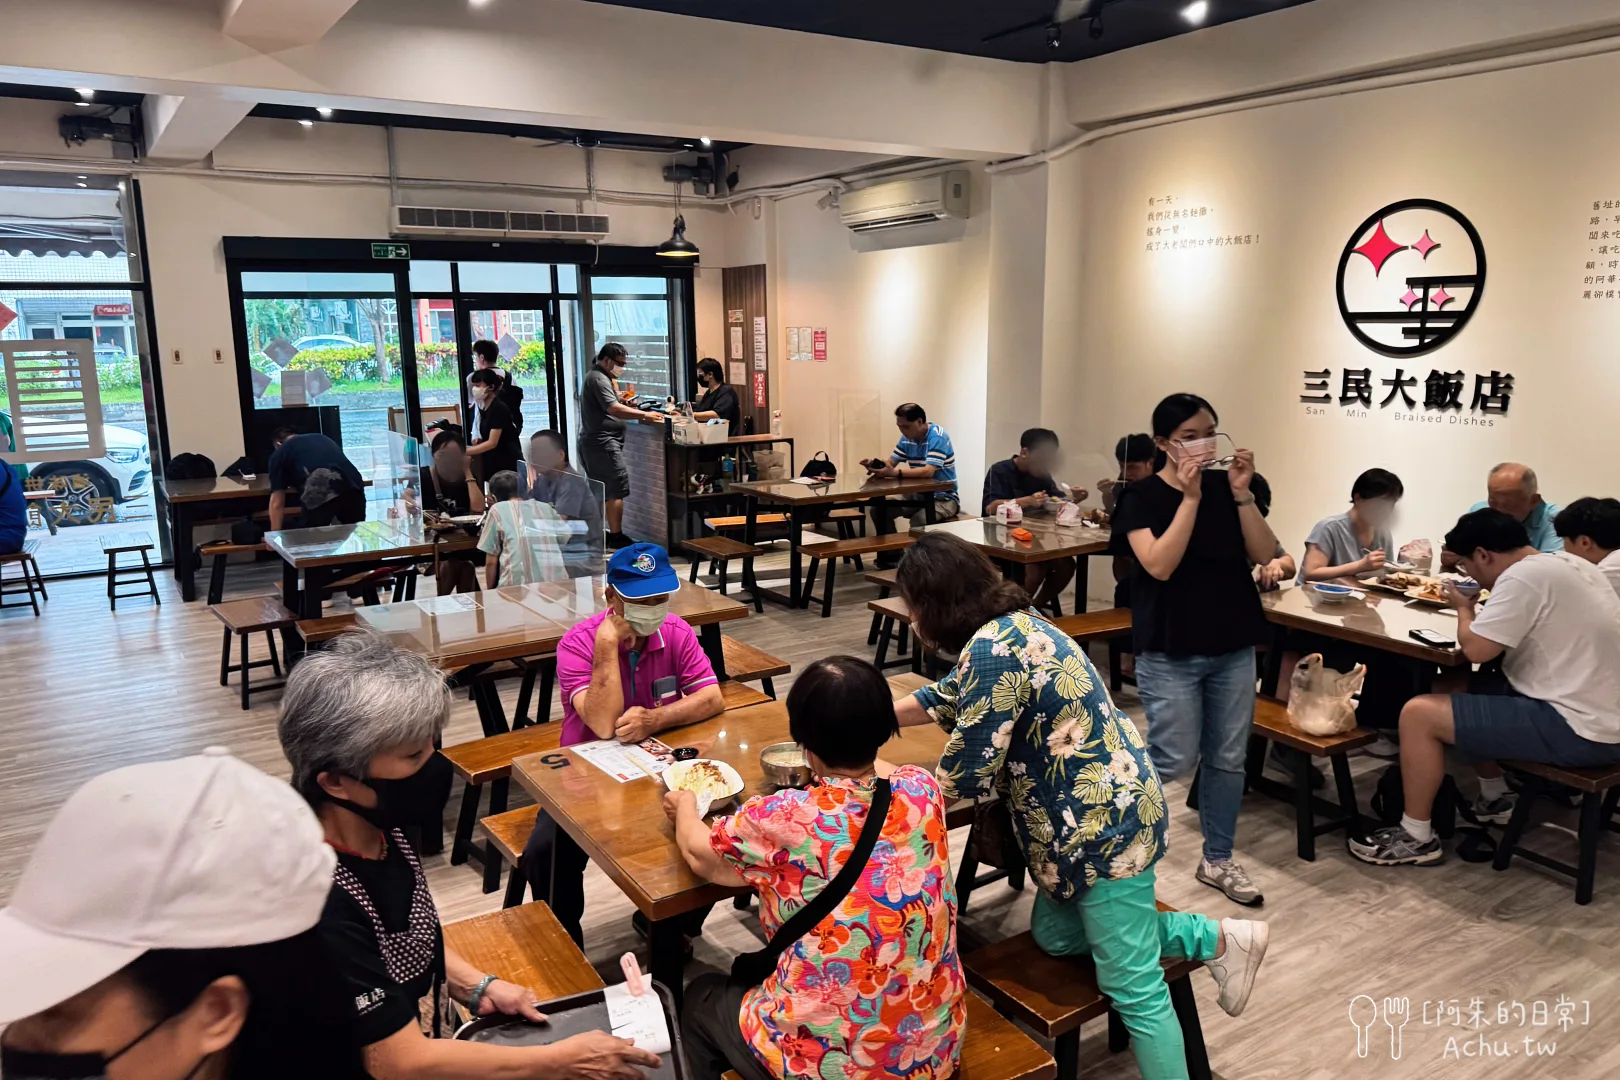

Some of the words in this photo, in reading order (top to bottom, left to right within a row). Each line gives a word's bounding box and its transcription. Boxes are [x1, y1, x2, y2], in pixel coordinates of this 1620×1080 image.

[1300, 367, 1515, 414] 三民大飯店
[1305, 406, 1326, 416] San
[1346, 408, 1368, 419] Min
[1394, 411, 1443, 424] Braised
[1449, 415, 1495, 427] Dishes
[540, 753, 571, 770] 5
